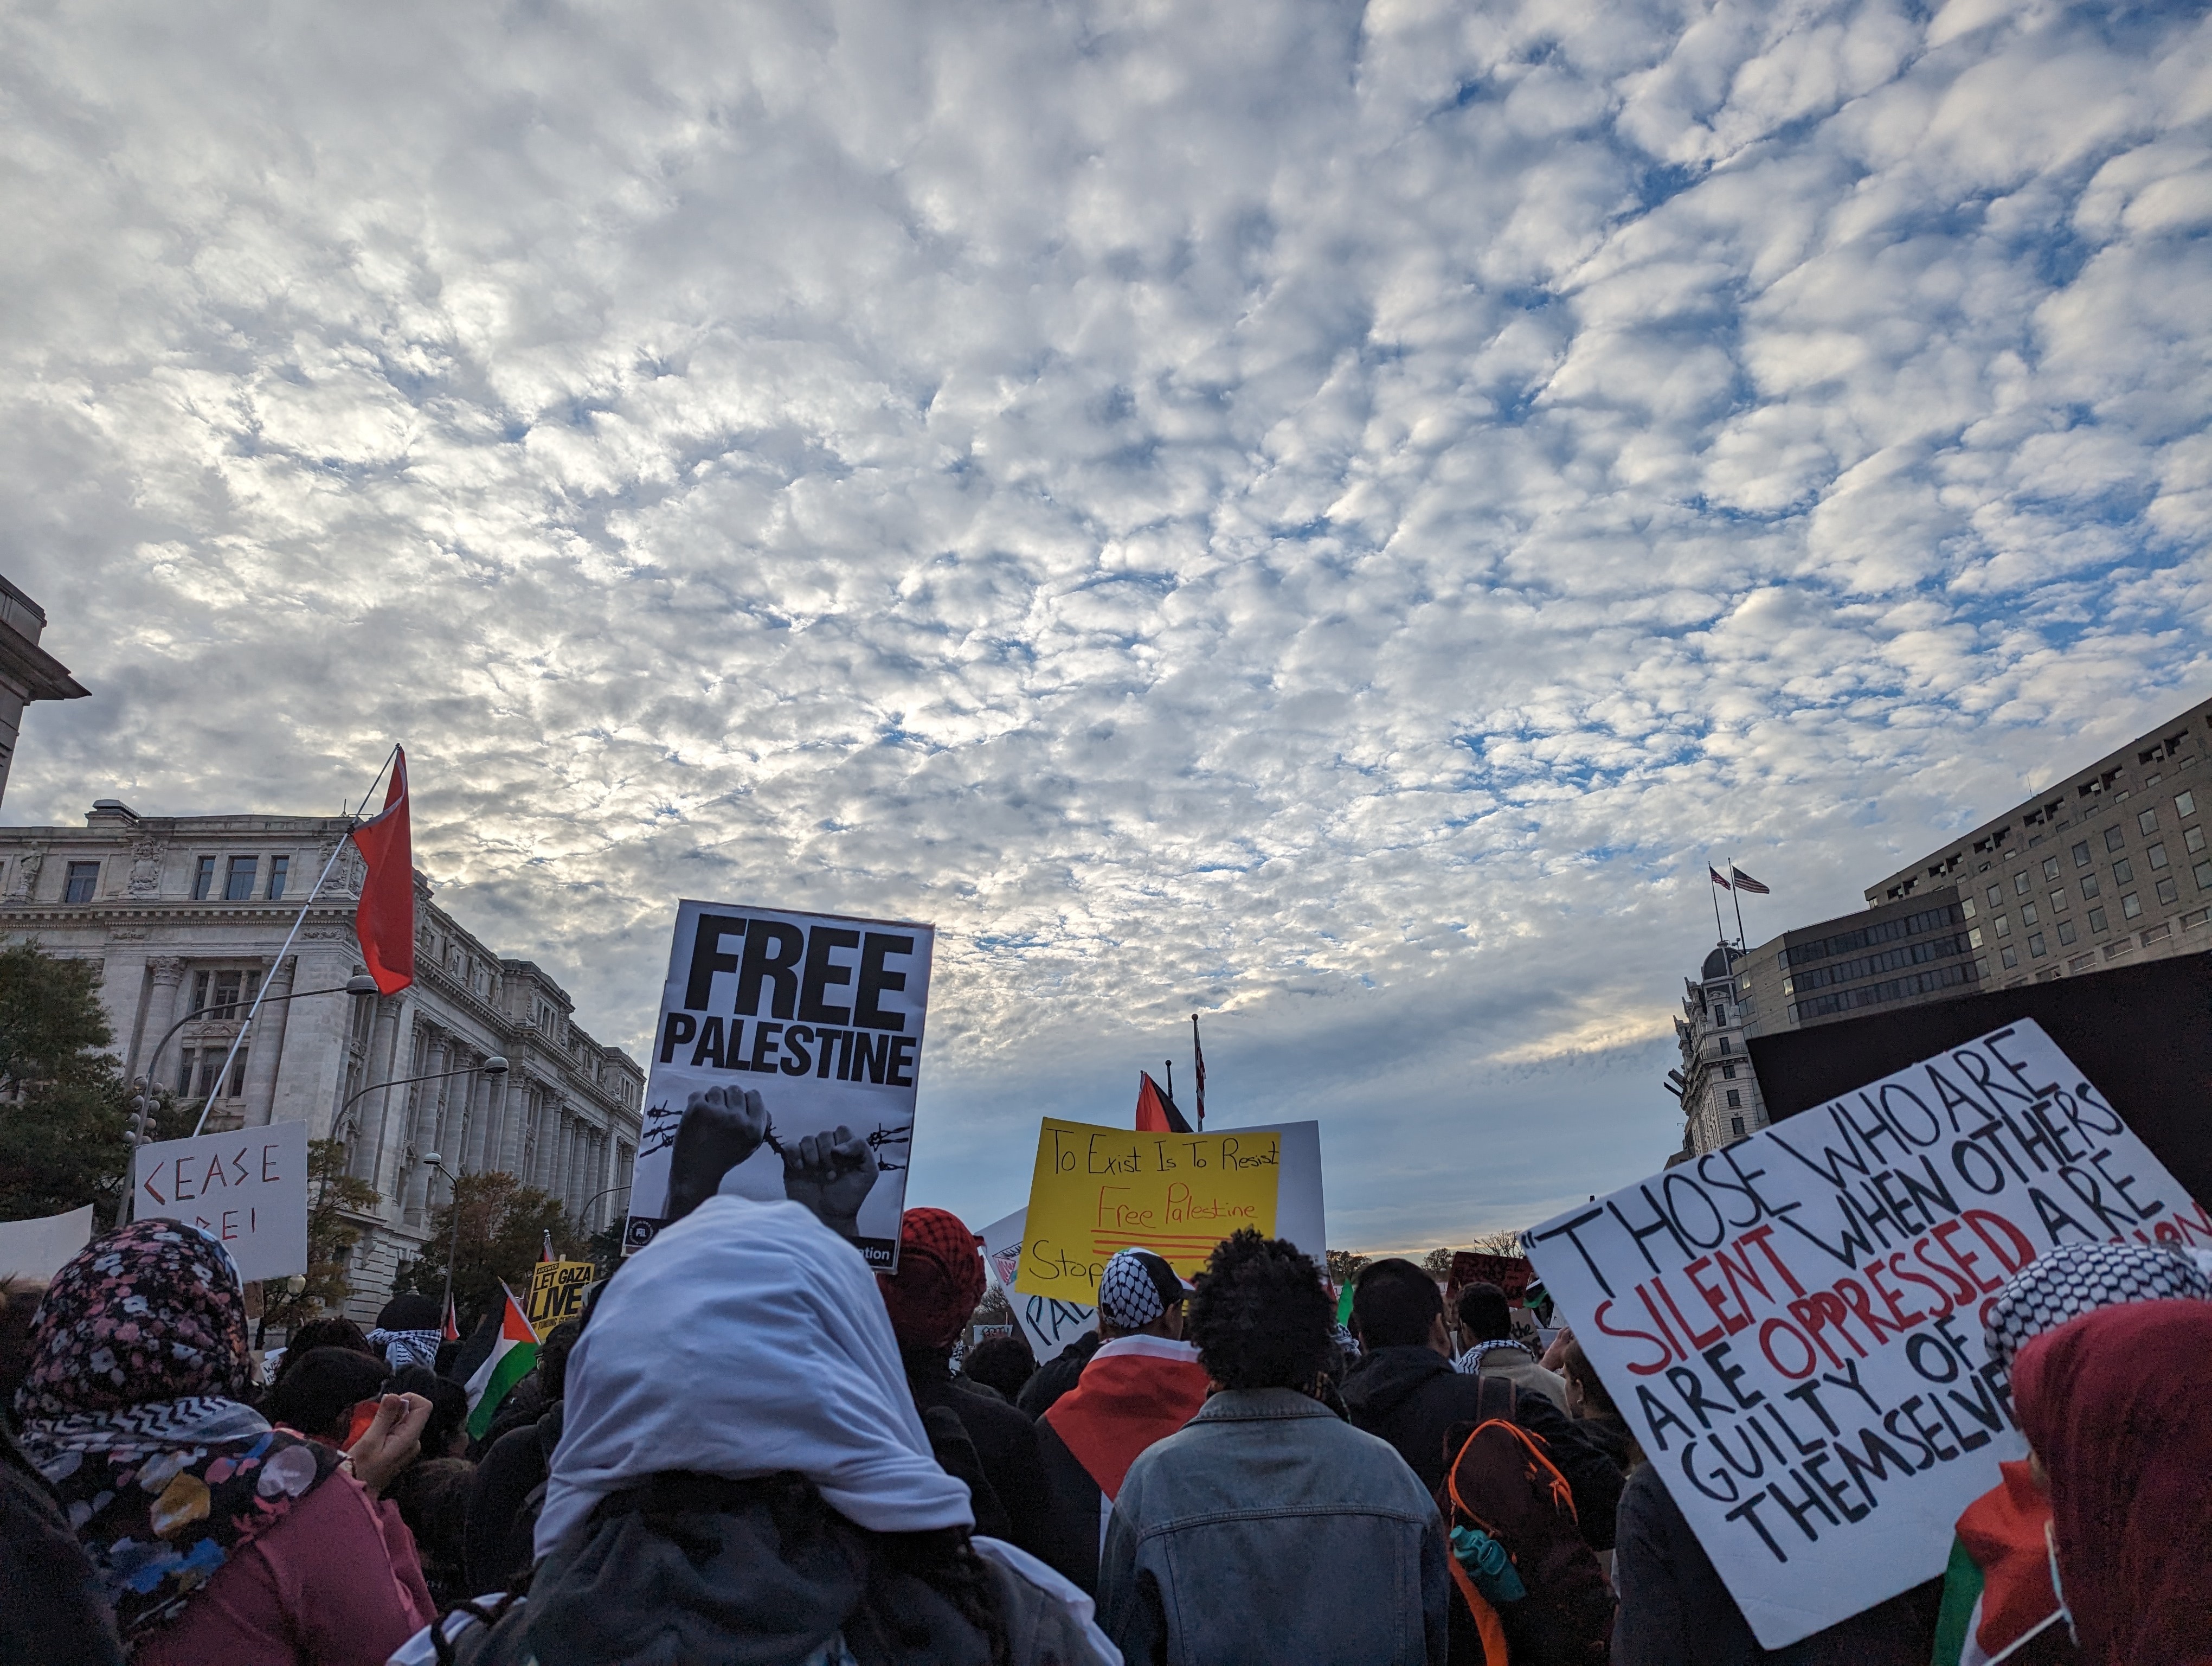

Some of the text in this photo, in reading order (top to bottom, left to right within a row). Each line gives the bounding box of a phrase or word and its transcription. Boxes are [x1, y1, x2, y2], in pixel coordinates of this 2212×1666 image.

[684, 913, 914, 1031] FREE
[659, 1012, 917, 1087] PALESTINE
[1765, 1085, 1940, 1190] WHO
[1925, 1028, 2061, 1132] ARE
[144, 1144, 280, 1206] CEASE
[1046, 1127, 1279, 1175] To Exist Is To Resist
[1098, 1182, 1258, 1229] Free Palestine
[1594, 1223, 1807, 1376] SILENT
[1779, 1154, 1963, 1271] WHEN
[1952, 1082, 2125, 1195] OTHERS
[533, 1266, 591, 1291] LET GAZA
[537, 1264, 558, 1274] ANSWER
[1030, 1240, 1104, 1288] Stop
[1635, 1342, 1766, 1451] ARE
[1758, 1209, 2037, 1380] OPPRESSED
[2028, 1148, 2165, 1246] ARE
[1681, 1314, 1975, 1502] GUILTY OF
[1725, 1358, 2021, 1563] THEMSELVE
